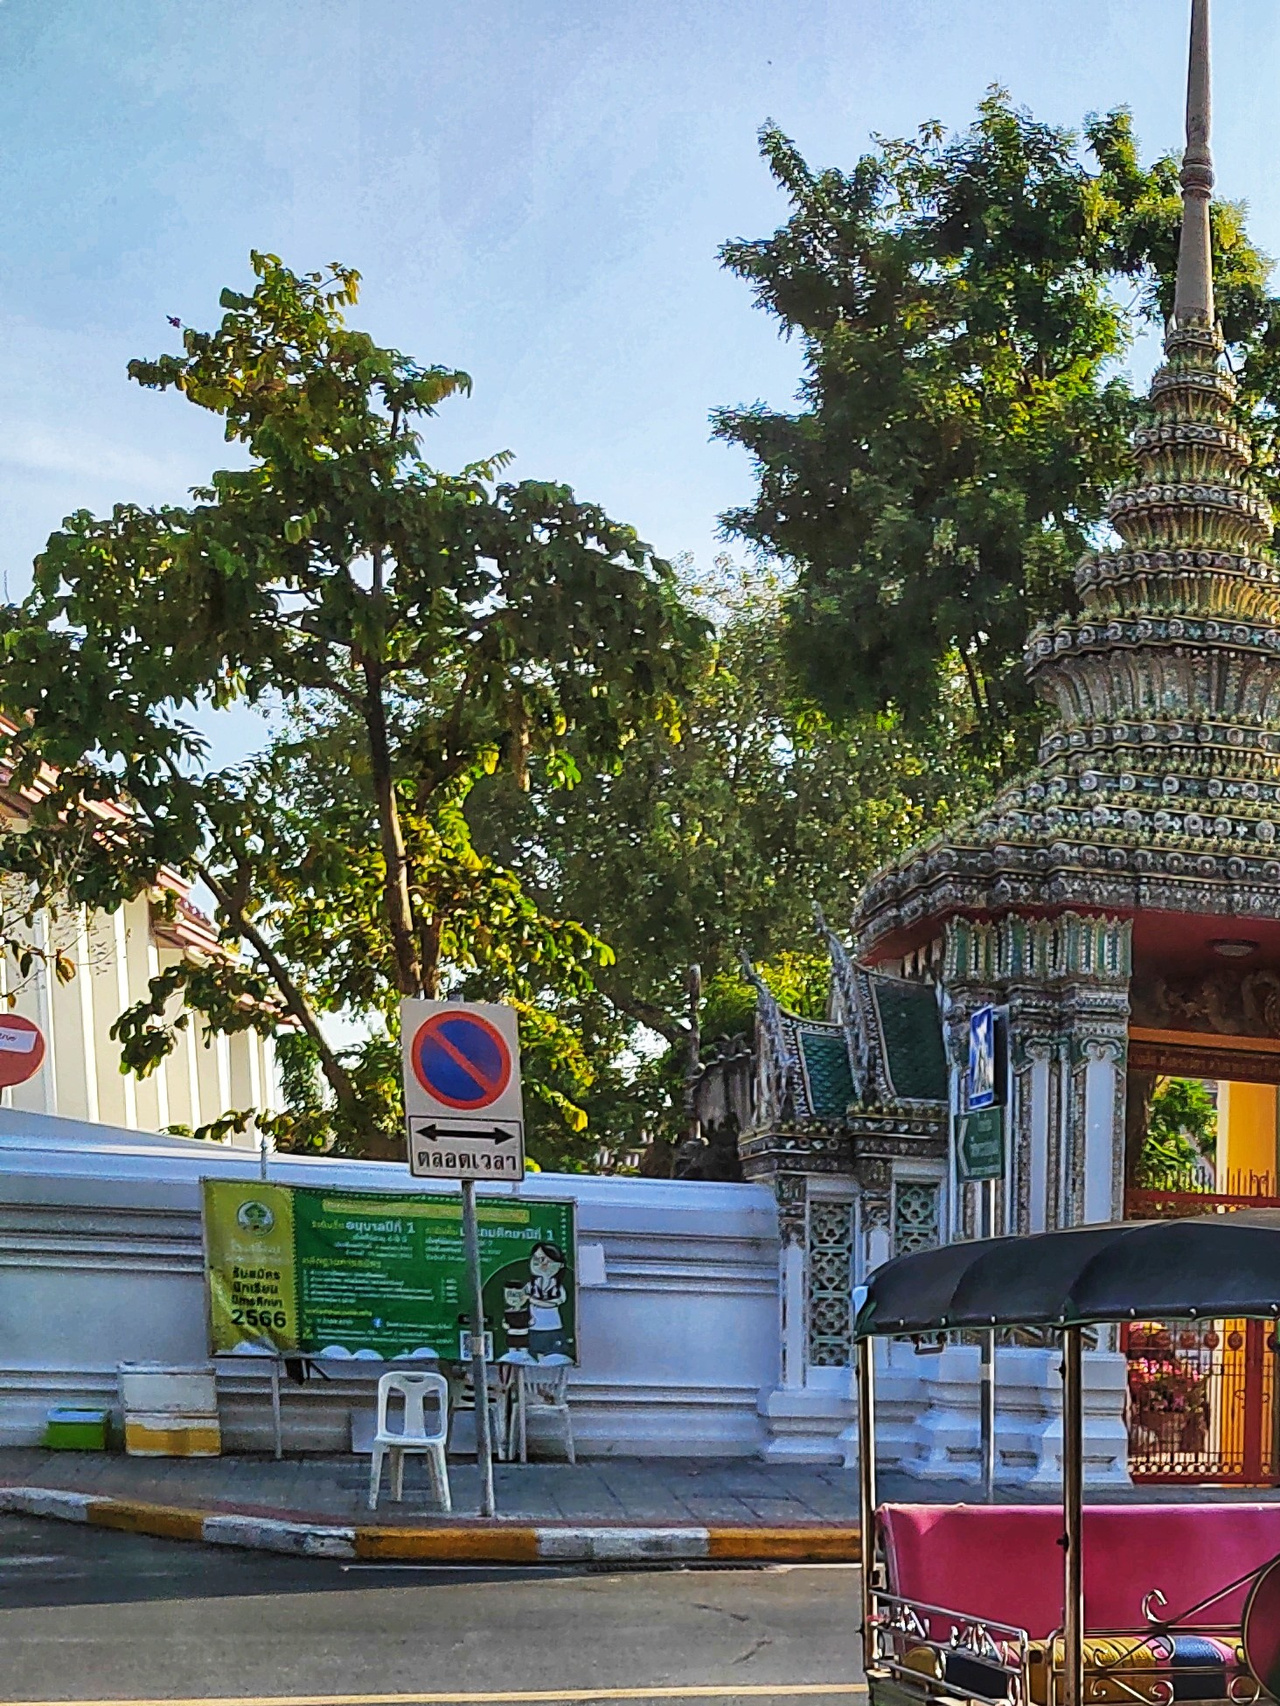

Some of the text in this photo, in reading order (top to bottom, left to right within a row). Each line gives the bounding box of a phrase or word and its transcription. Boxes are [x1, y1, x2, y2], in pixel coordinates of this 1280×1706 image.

[417, 1150, 517, 1172] ตลอดเวลา
[231, 1308, 287, 1328] 2566
